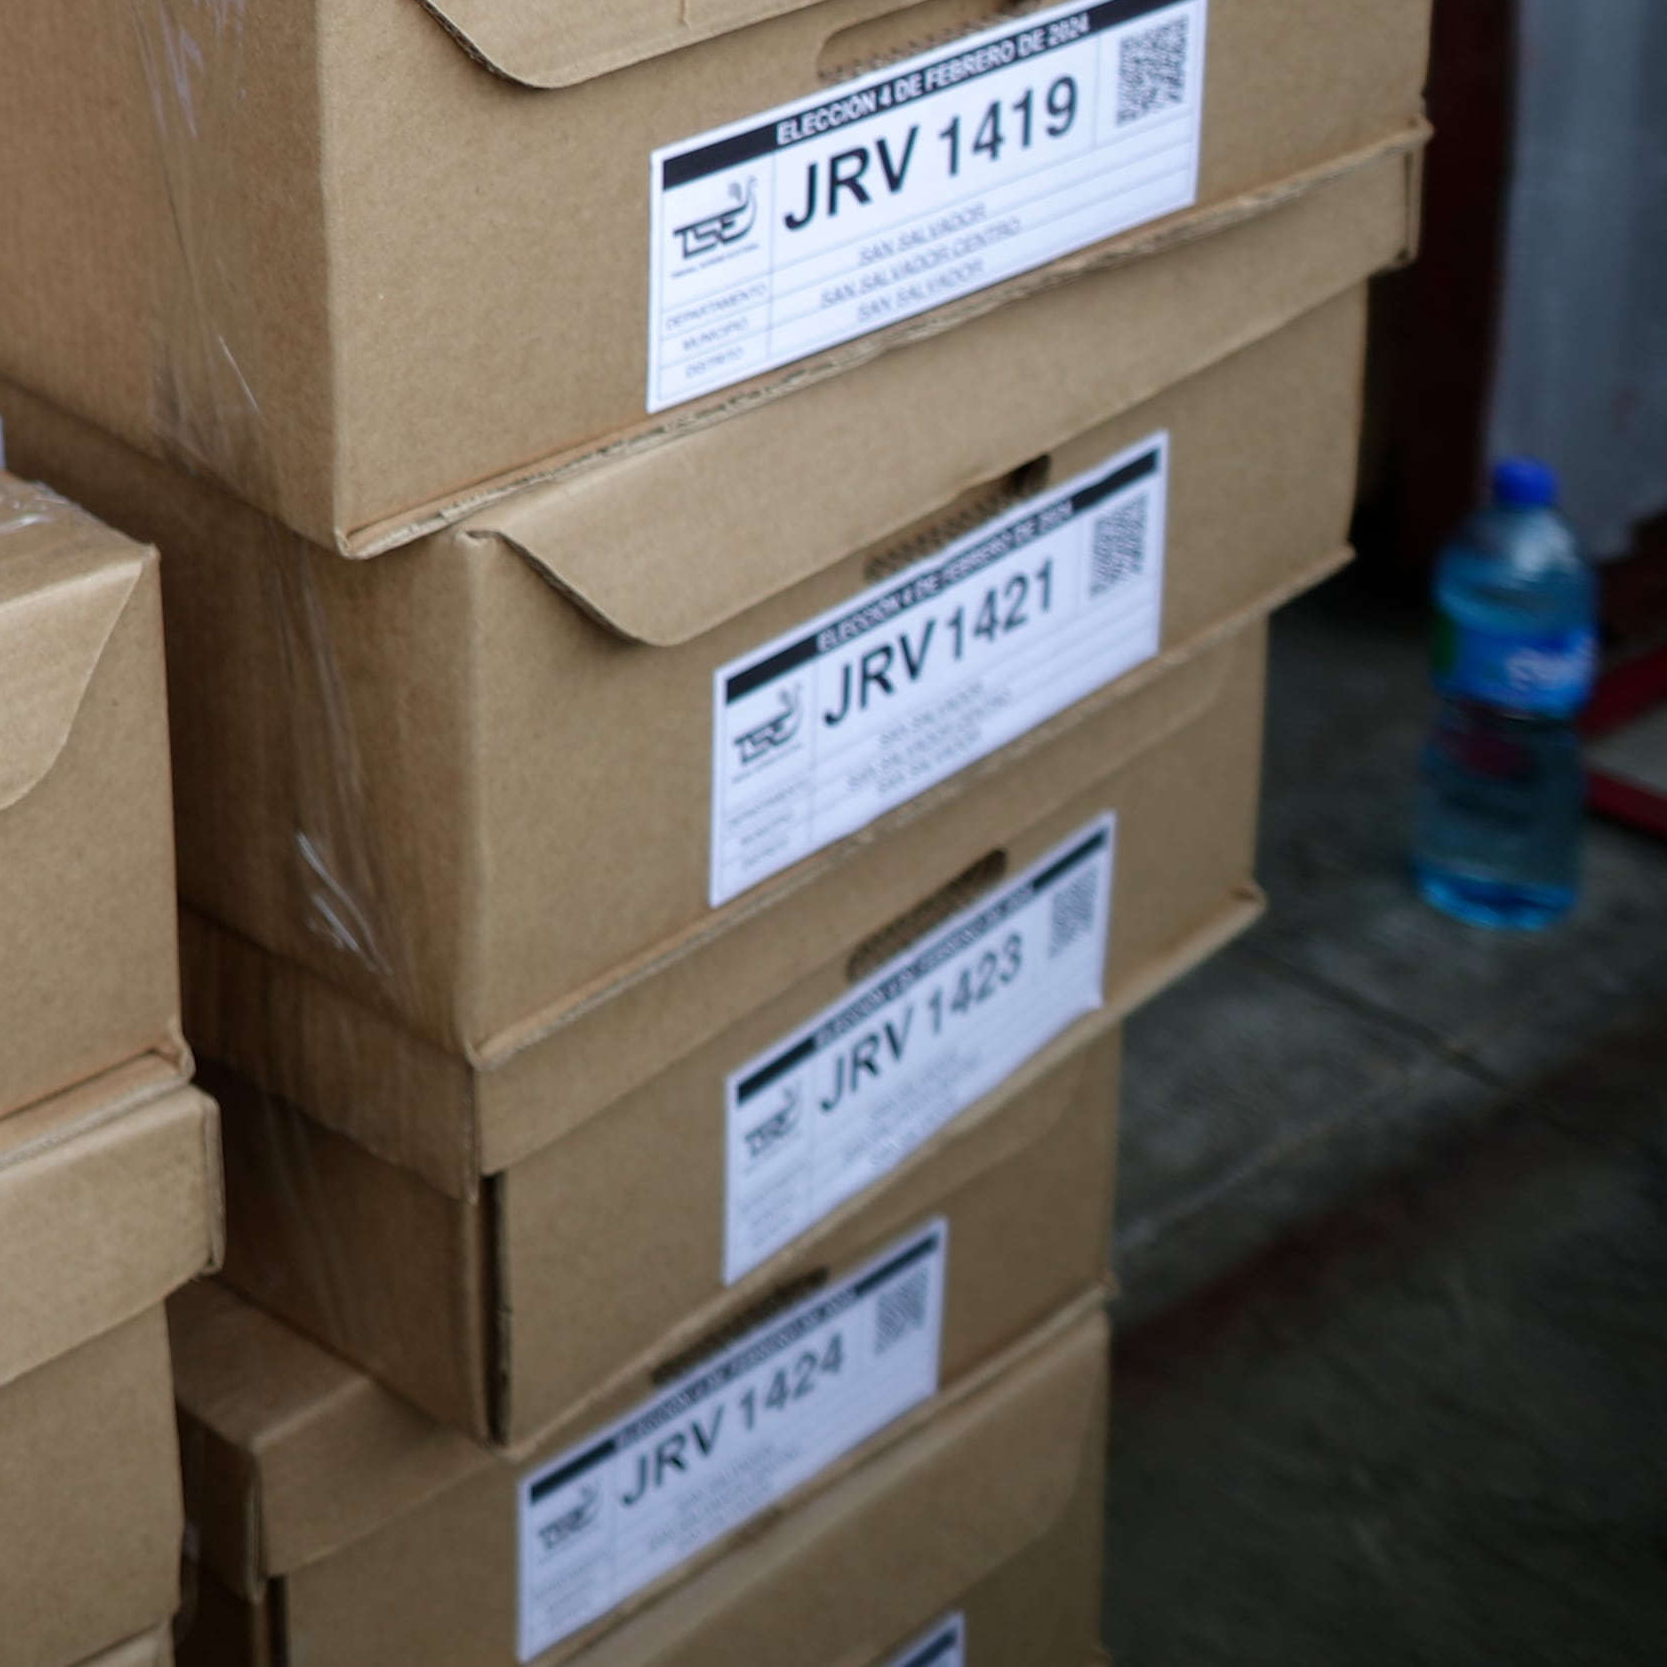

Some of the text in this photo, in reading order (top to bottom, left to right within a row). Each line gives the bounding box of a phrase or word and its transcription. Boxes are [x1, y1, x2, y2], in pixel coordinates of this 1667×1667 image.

[895, 75, 922, 102] DE
[924, 40, 1015, 91] FEBRERO
[1017, 27, 1046, 56] DE
[784, 75, 1079, 232] JRV 1419
[824, 558, 1053, 728] JRV 1421
[821, 1003, 913, 1112] JRV
[927, 932, 1024, 1034] 1423
[621, 1405, 726, 1507] JRV
[739, 1332, 845, 1431] 1424
